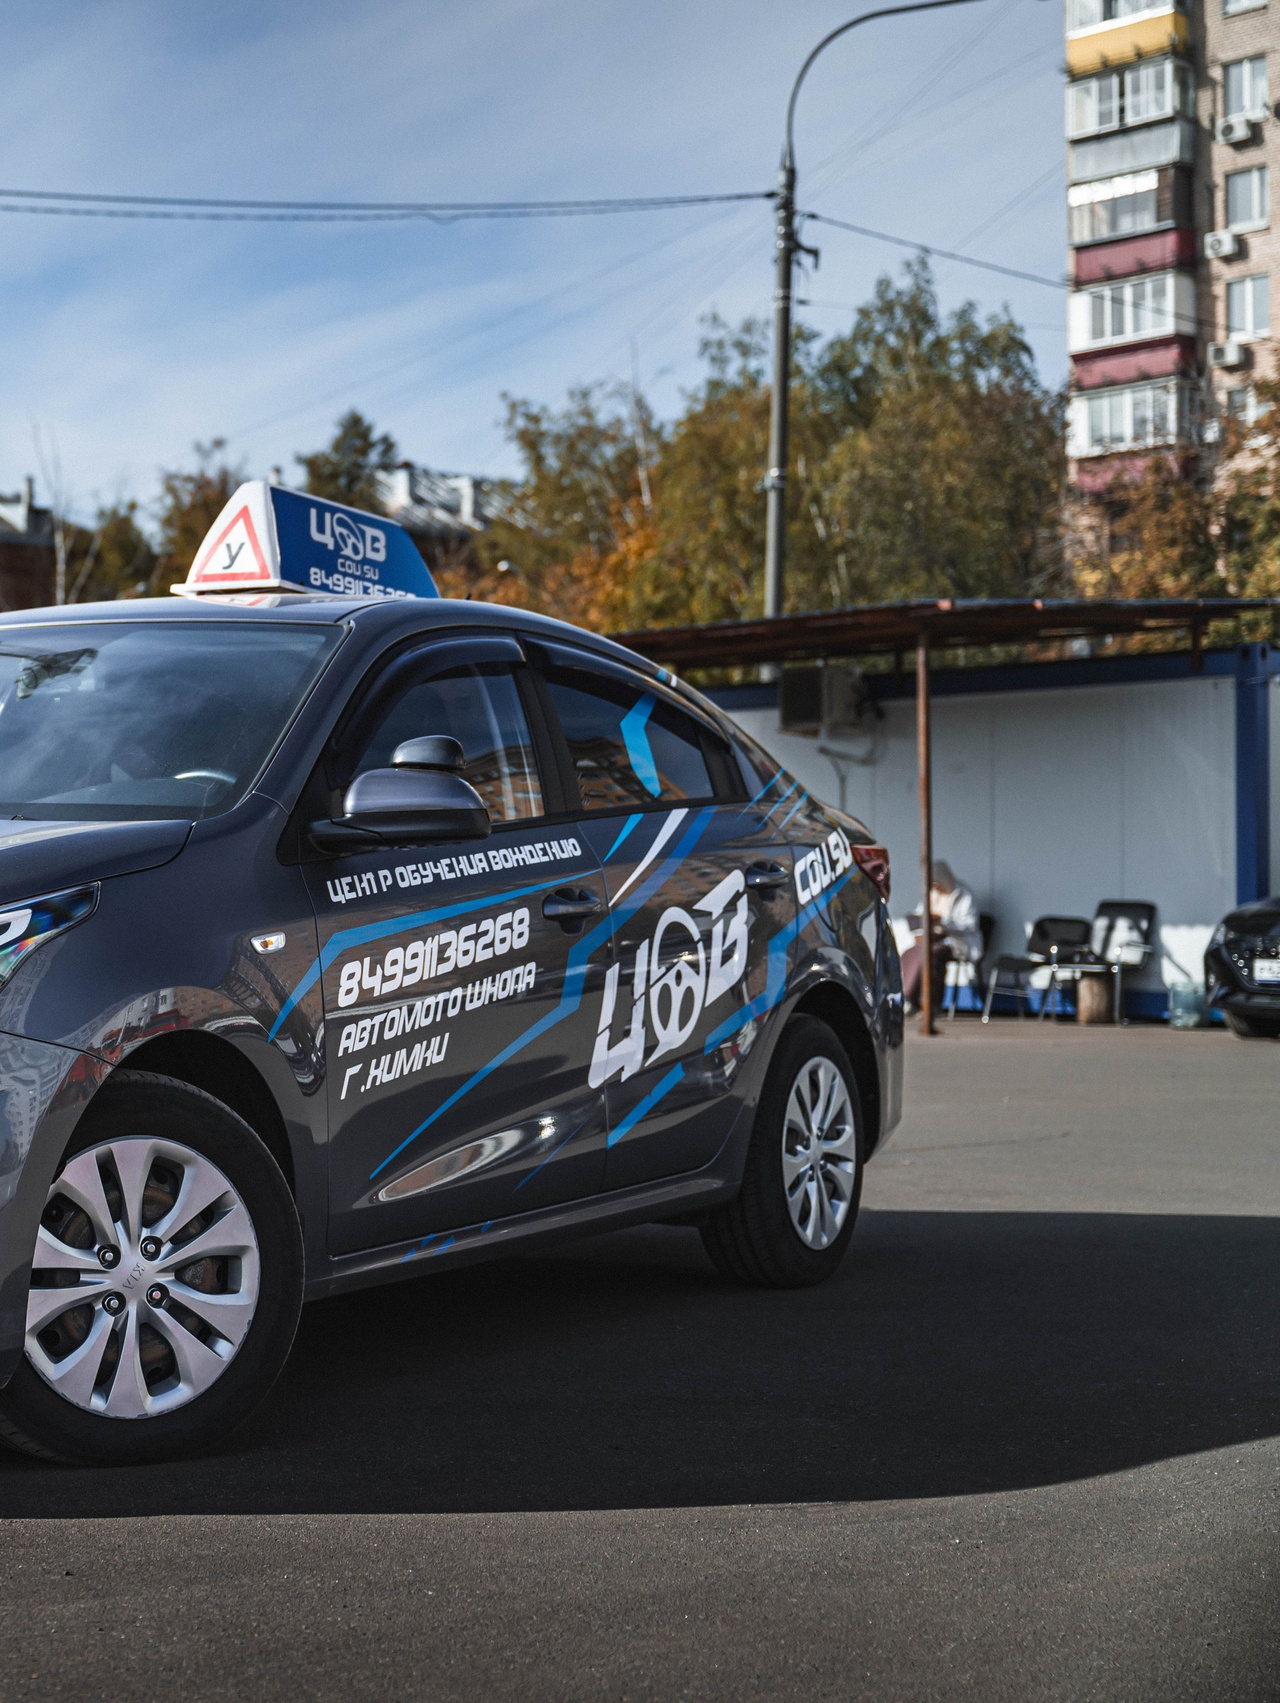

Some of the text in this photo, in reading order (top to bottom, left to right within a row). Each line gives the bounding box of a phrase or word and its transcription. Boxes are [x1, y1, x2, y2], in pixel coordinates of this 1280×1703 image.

[222, 542, 245, 570] У
[394, 852, 490, 889] ОБУЧЕНИЯ
[486, 838, 582, 872] ВОЖДЕНИЮ
[337, 906, 531, 1008] 84991136268
[337, 961, 537, 1058] АВТОМОТО ШКОЛА
